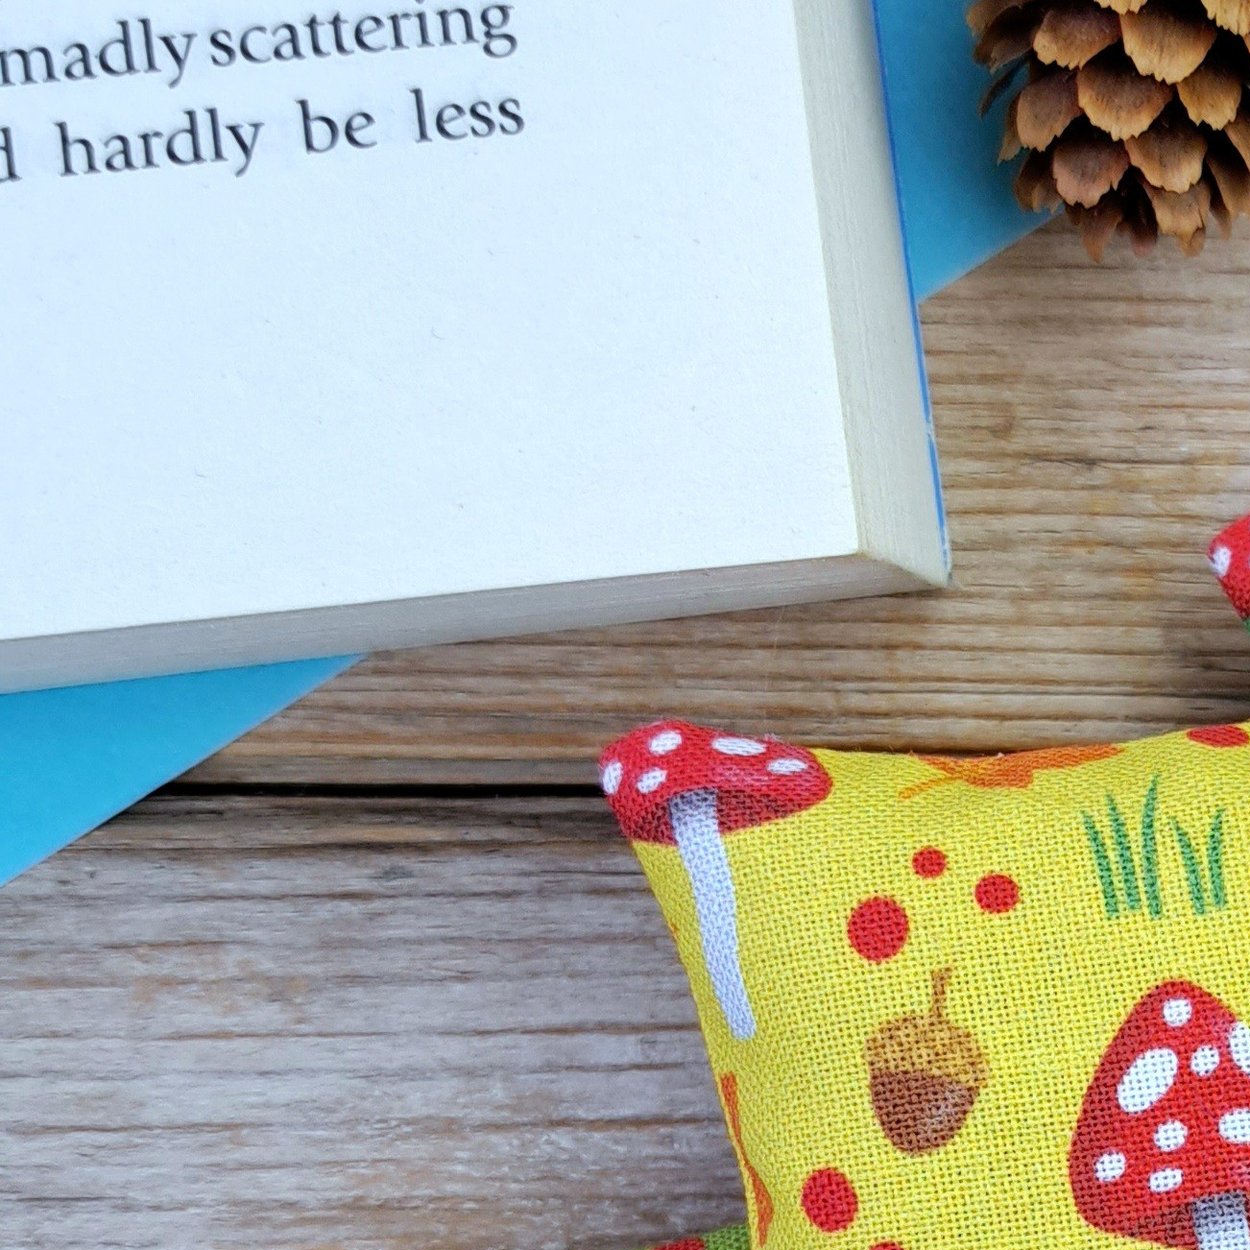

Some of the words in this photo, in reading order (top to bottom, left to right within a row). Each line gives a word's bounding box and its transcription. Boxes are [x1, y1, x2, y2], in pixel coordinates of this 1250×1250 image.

[0, 19, 197, 88] madly
[209, 0, 518, 67] scattering
[56, 109, 264, 178] hardly
[295, 98, 378, 155] be
[409, 88, 525, 144] less
